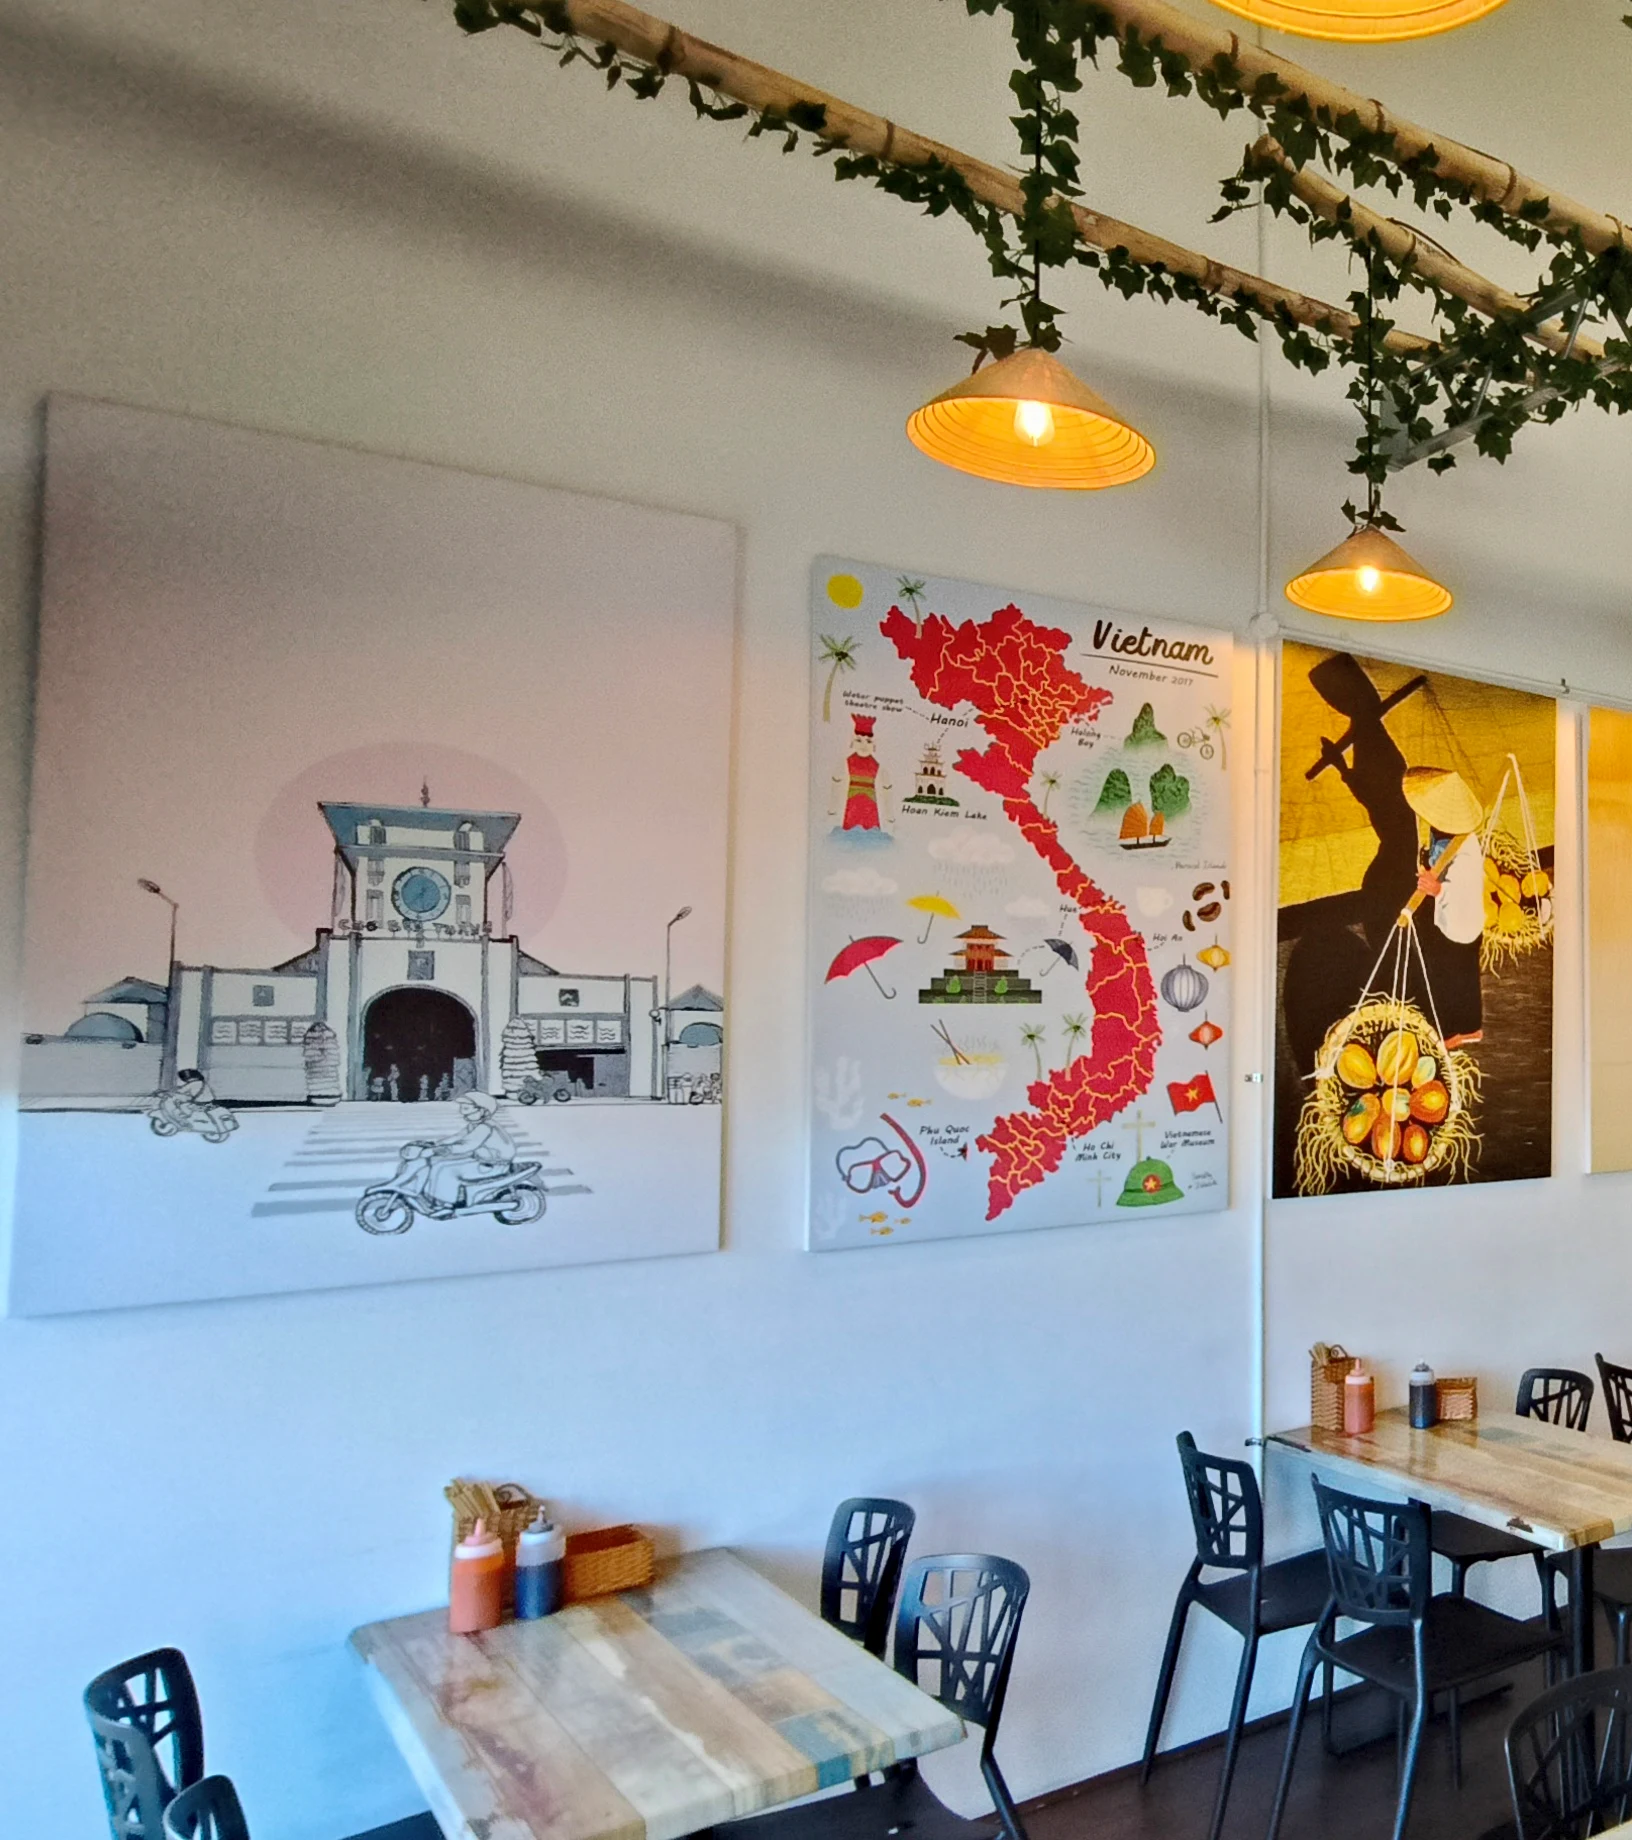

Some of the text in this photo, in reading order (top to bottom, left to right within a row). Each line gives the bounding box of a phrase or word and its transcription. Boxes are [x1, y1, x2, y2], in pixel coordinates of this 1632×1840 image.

[1093, 619, 1214, 665] Vietnam
[1108, 664, 1194, 687] November 2017
[930, 712, 969, 728] Hanoi
[1078, 738, 1094, 748] Bay
[901, 805, 987, 820] Hoan Kiem Lake
[1153, 933, 1183, 942] Hoi An
[919, 1124, 970, 1135] Phu Quoc
[1164, 1129, 1212, 1140] Vietnamese
[930, 1135, 960, 1146] Island
[1160, 1138, 1215, 1149] War Museum
[1083, 1141, 1115, 1152] Ho Chi
[1075, 1151, 1121, 1162] Minh City
